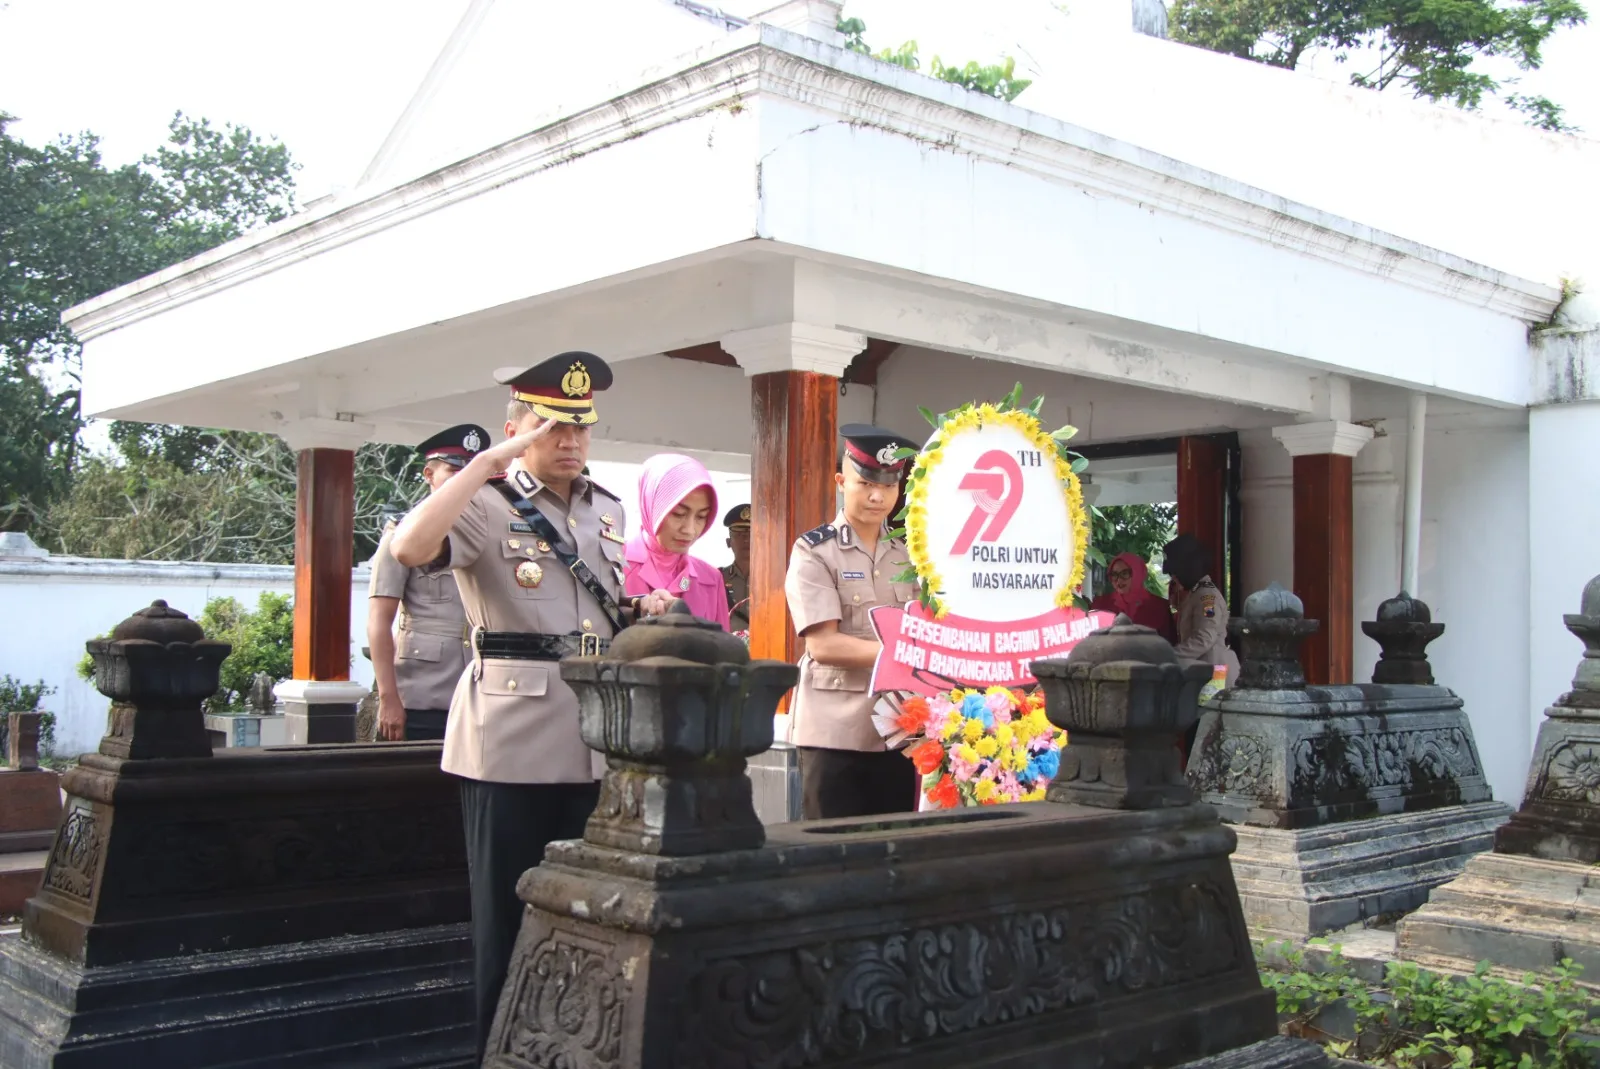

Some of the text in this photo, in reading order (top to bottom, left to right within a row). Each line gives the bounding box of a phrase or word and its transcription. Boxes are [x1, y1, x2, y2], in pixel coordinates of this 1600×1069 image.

[1017, 450, 1042, 467] TH
[972, 546, 1058, 564] POLRI UNTUK
[972, 572, 1054, 590] MASYARAKAT
[900, 613, 990, 653] PERSEMBAHAN
[1041, 615, 1099, 648] PAHLAWAN
[894, 640, 926, 670] HARI
[928, 651, 1015, 682] BHAYANGKARA
